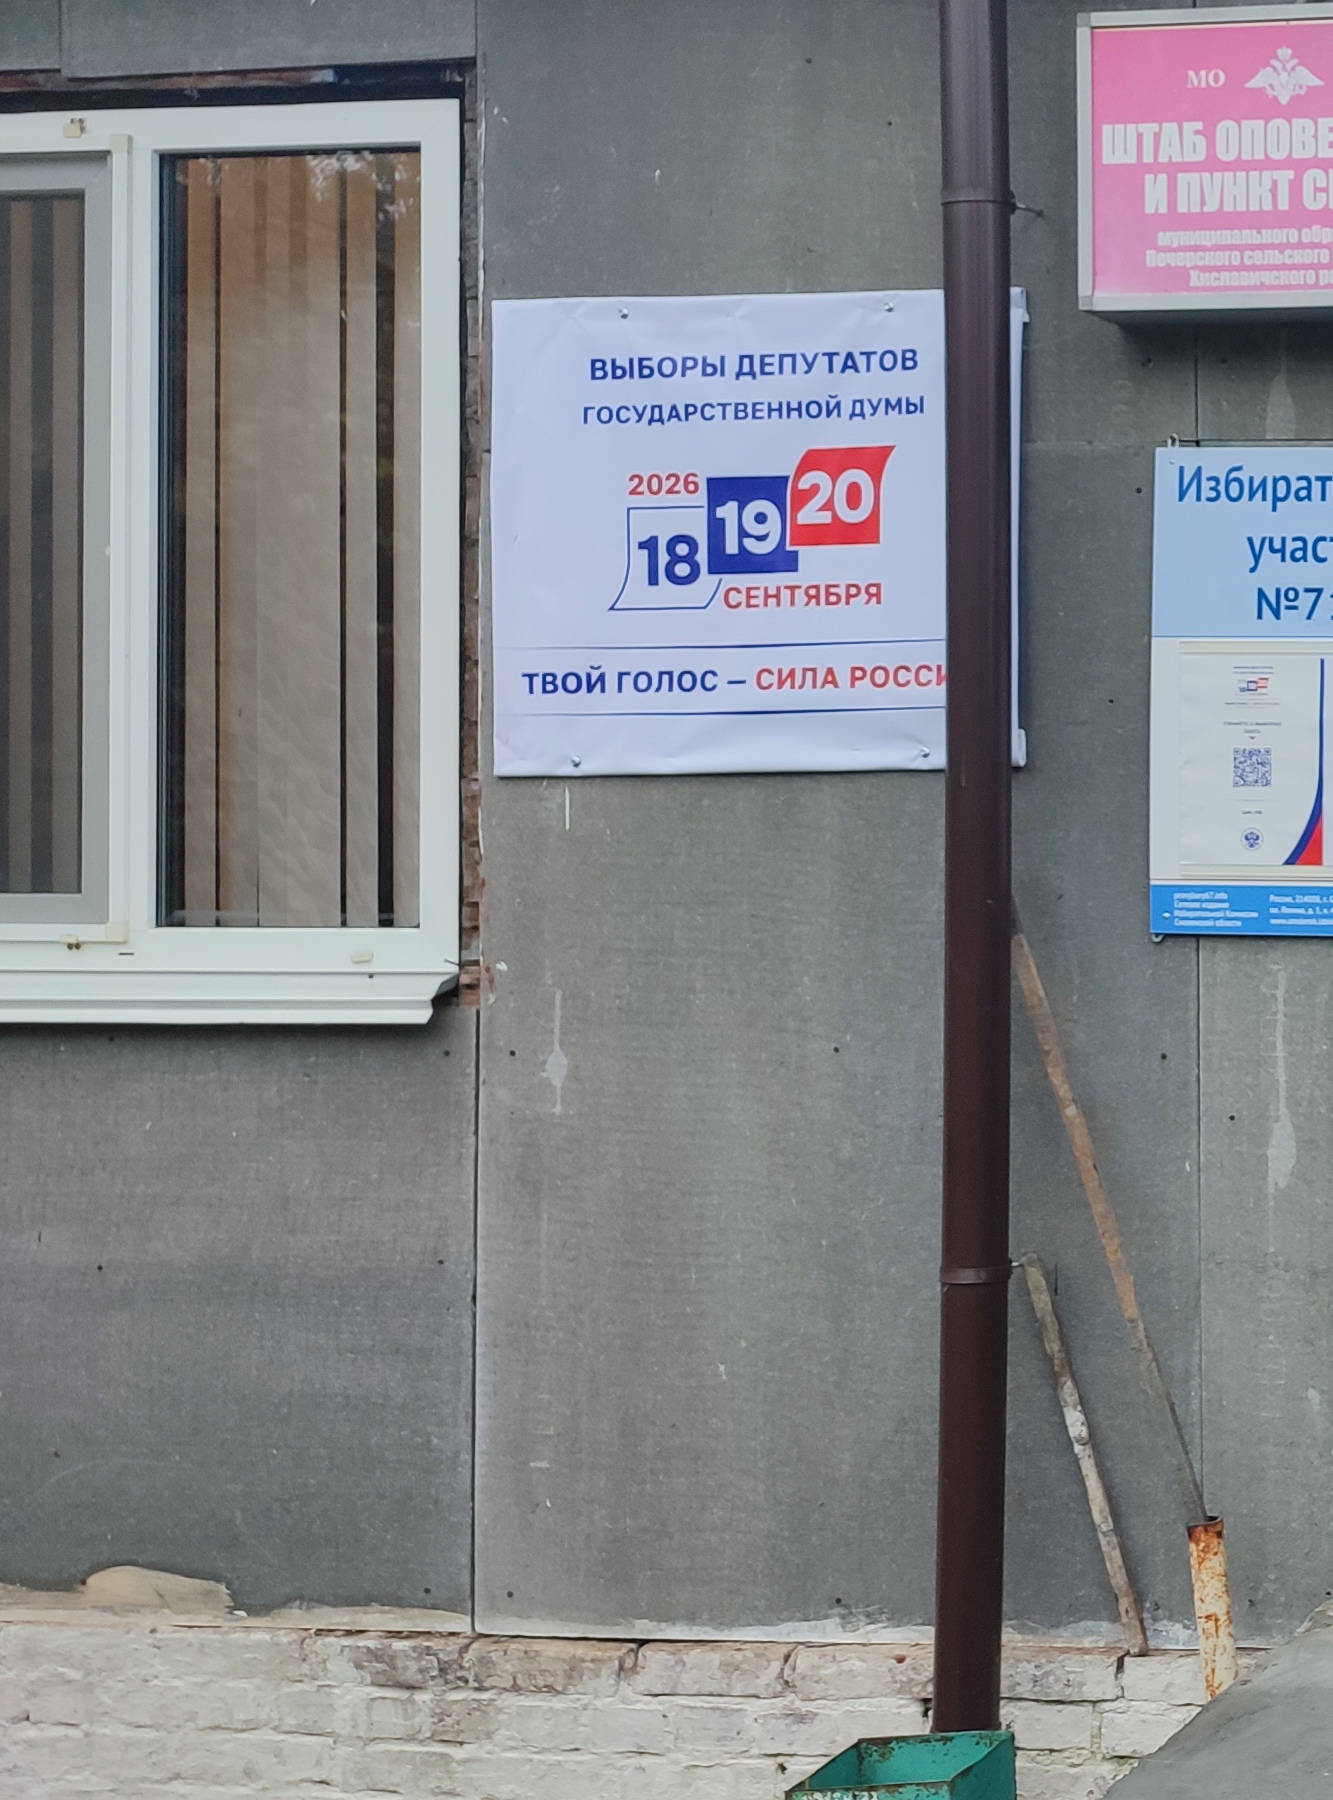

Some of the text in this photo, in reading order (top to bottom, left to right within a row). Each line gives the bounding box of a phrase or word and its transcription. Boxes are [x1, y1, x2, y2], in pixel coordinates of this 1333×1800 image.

[1186, 69, 1226, 89] МО
[1101, 122, 1207, 165] ШТАБ
[1144, 173, 1168, 214] И
[1176, 169, 1295, 213] ПУНКТ
[1158, 227, 1299, 248] муниципального
[1145, 250, 1241, 268] Печерского
[1243, 248, 1330, 266] сельского
[589, 348, 919, 381] ВЫБОРЫ ДЕПУТАТОВ
[582, 395, 926, 427] ГОСУДАРСТВЕННОЙ ДУМЫ
[627, 473, 700, 496] 2026
[637, 469, 875, 586] 18 19 20
[723, 582, 883, 610] СЕНТЯБРЯ
[522, 665, 606, 694] ТВОЙ
[617, 670, 719, 694] ГОЛОС
[755, 666, 840, 691] СИЛА
[849, 663, 946, 689] РОССИ
